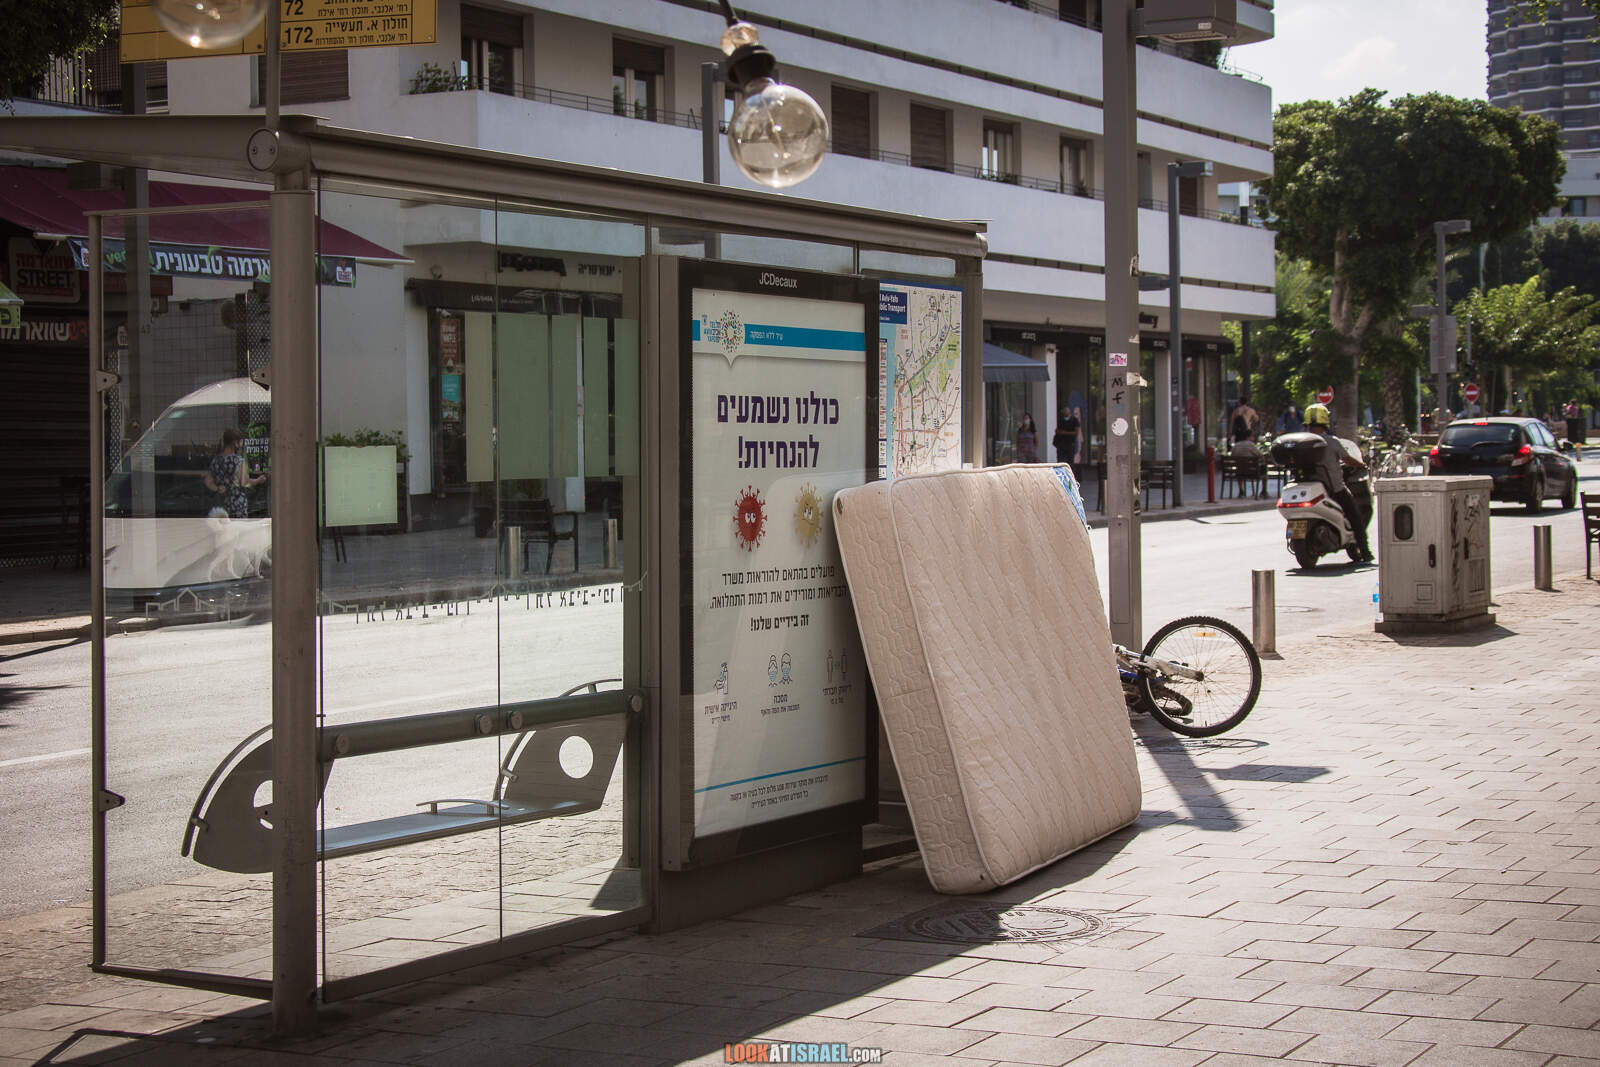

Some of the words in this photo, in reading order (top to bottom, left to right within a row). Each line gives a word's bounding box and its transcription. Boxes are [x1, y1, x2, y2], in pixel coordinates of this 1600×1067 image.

[285, 0, 304, 16] 72
[325, 21, 363, 33] תעשייה
[382, 17, 408, 31] חולון
[285, 26, 313, 44] 172
[154, 251, 223, 275] טבעונית
[17, 269, 73, 288] STREET
[759, 272, 798, 288] JCDecaux
[0, 321, 70, 342] שווארמ
[717, 394, 790, 423] נשמעים
[795, 391, 839, 424] כולנו
[738, 434, 820, 468] להנחיות!
[721, 571, 744, 585] משרד
[746, 567, 780, 583] להוראות
[782, 567, 809, 581] בהתאם
[810, 565, 835, 579] פועלים
[709, 593, 746, 609] התחלואה.
[748, 593, 768, 605] רמות
[770, 592, 782, 603] את
[784, 588, 816, 601] ומורידים
[750, 616, 772, 631] שלנו!
[774, 616, 799, 628] בידיים
[800, 614, 809, 627] זה
